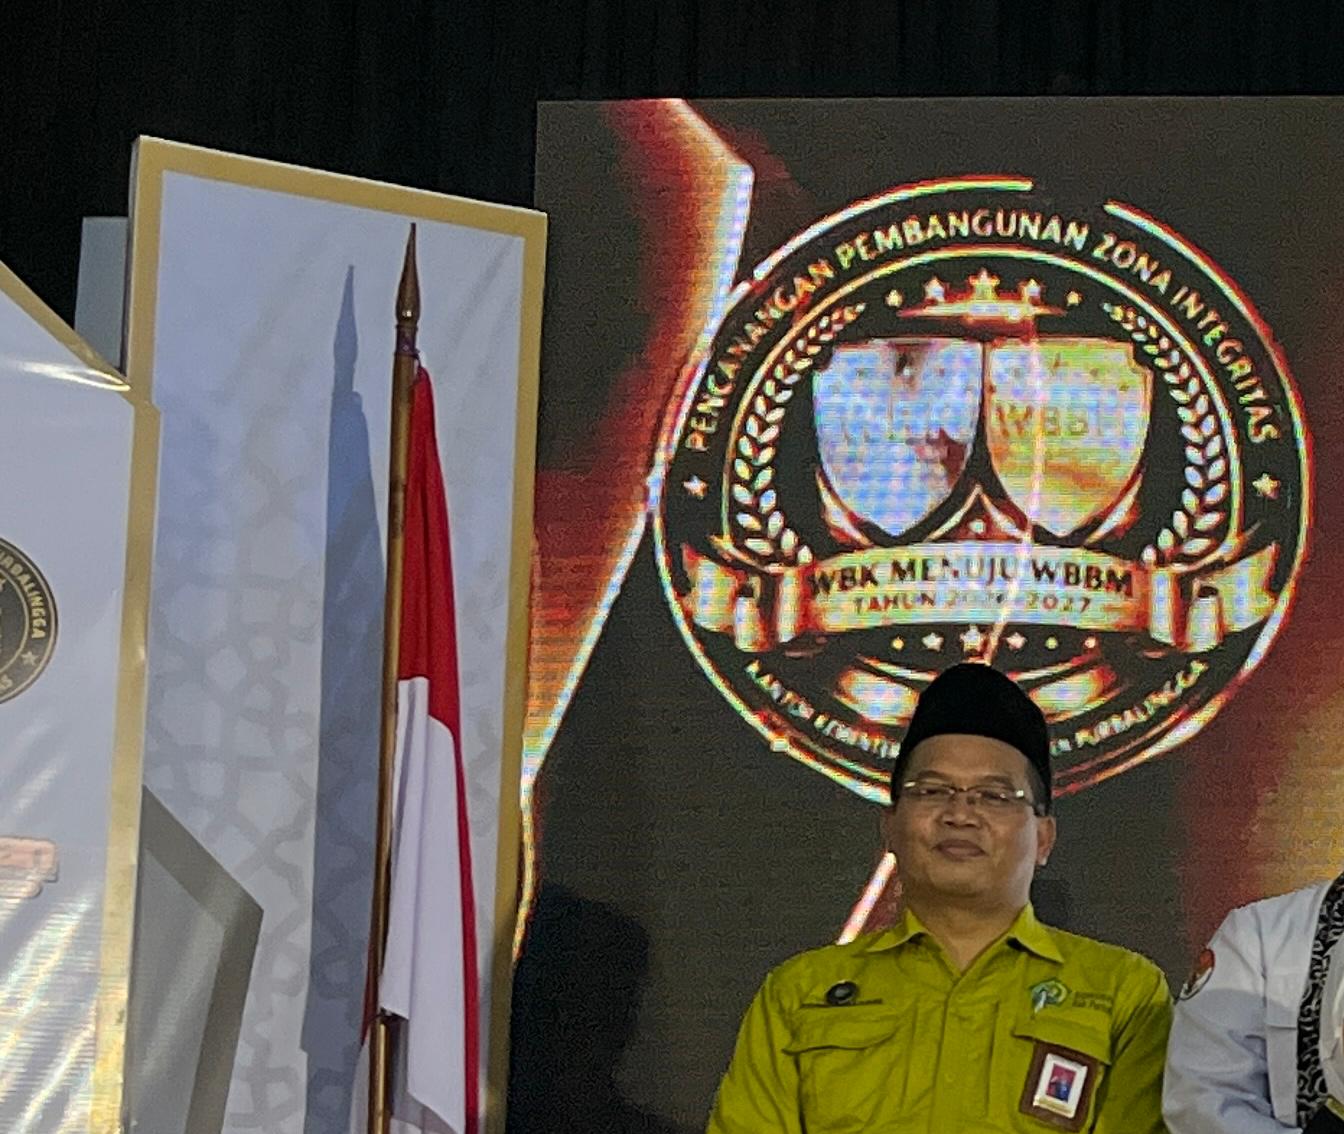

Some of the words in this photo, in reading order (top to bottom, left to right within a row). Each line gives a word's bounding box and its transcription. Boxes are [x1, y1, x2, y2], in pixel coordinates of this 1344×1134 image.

[834, 208, 1090, 270] PEMBANGUNAN
[1092, 231, 1173, 294] ZONA
[1170, 285, 1281, 443] INTEGRITAS
[0, 552, 47, 639] RBALINGGA
[808, 564, 880, 597] WBK
[891, 556, 1017, 587] MENUJU
[1031, 560, 1136, 599] WBBM
